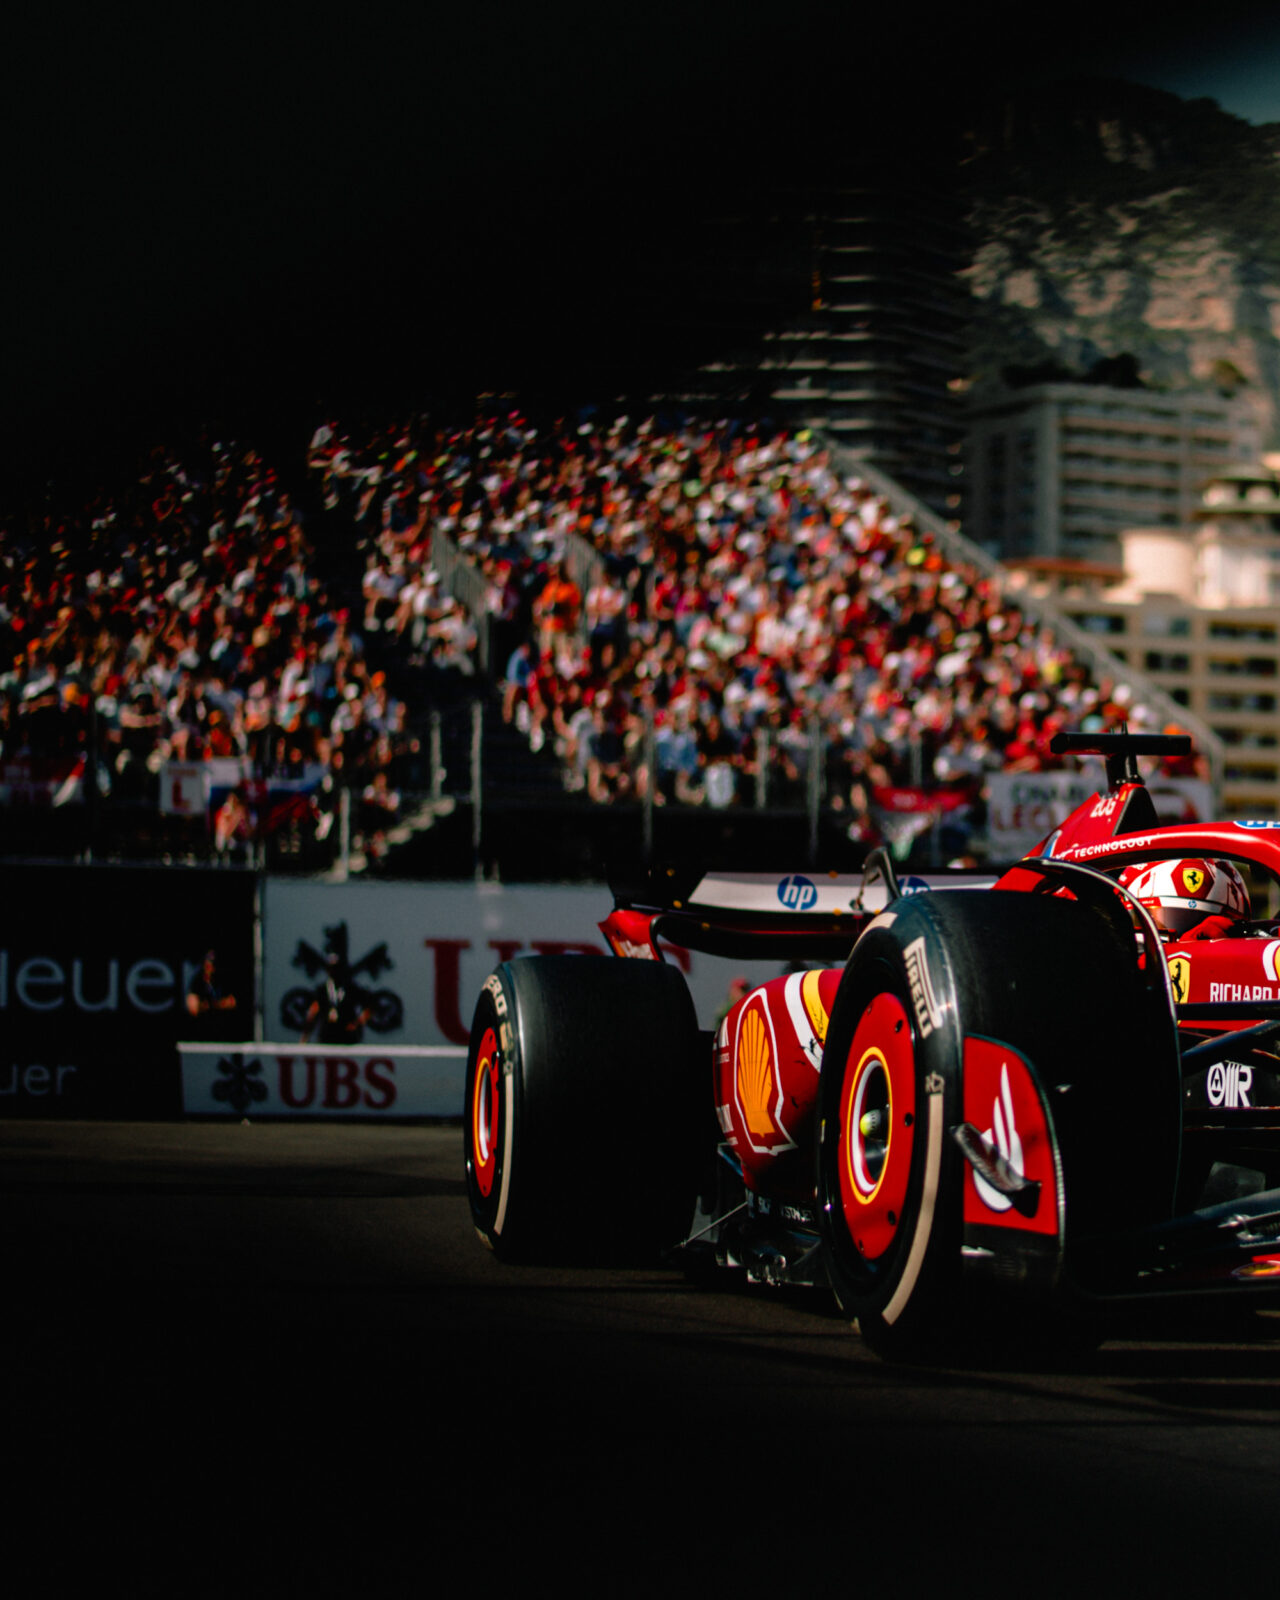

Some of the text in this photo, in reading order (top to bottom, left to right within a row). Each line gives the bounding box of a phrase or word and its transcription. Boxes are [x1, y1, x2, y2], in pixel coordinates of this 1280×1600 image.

[1074, 838, 1152, 859] TECHNOLOGY
[779, 876, 817, 910] hp
[902, 936, 943, 1040] PIRELLI
[1209, 981, 1273, 1003] RICHARD
[277, 1057, 398, 1110] UBS
